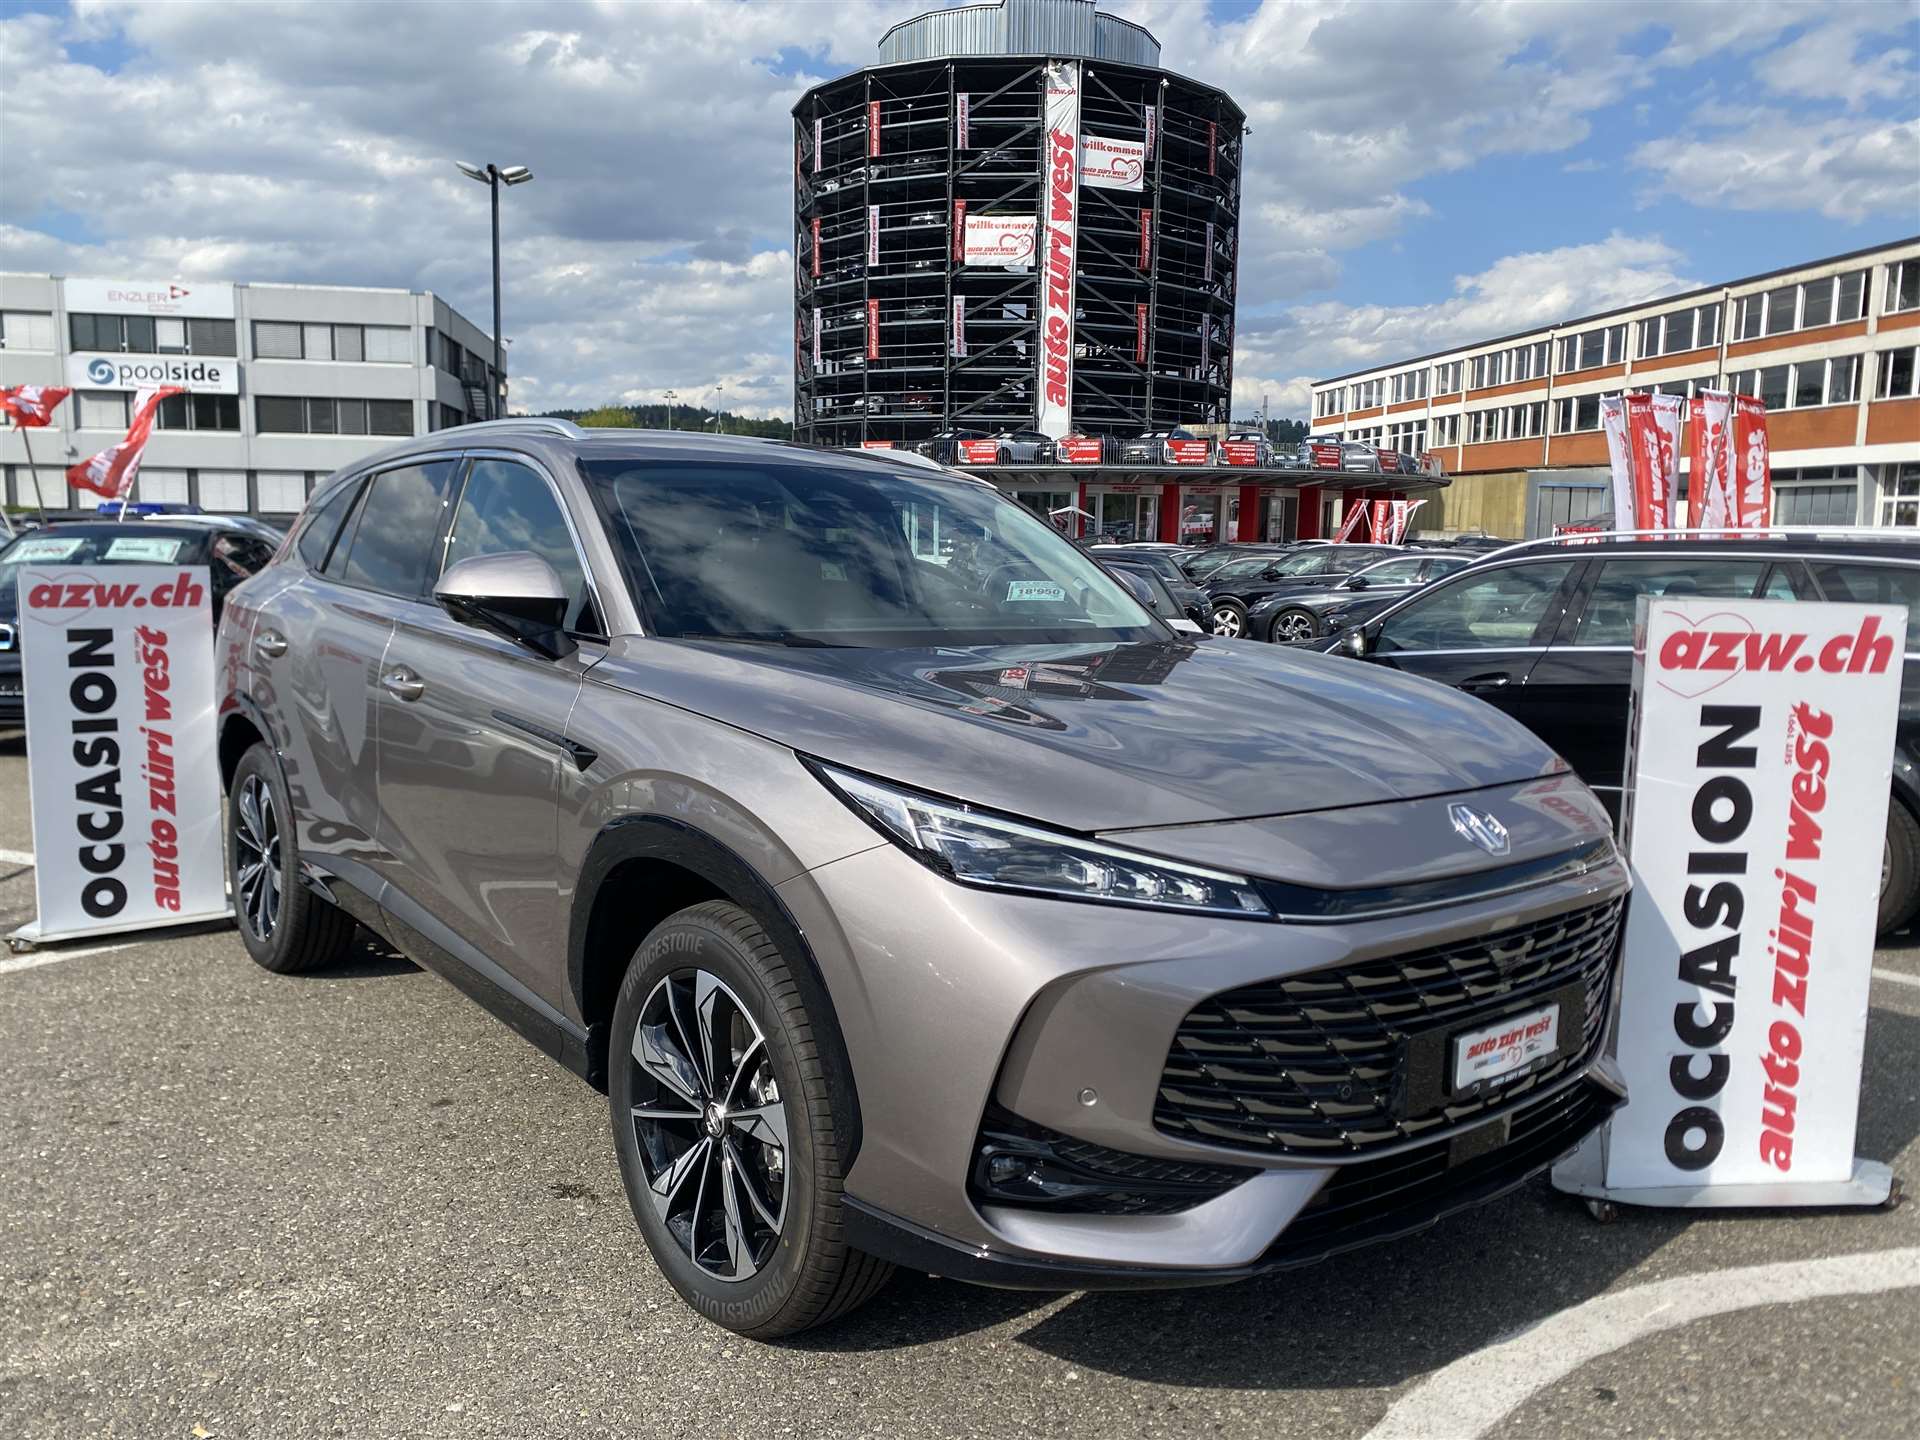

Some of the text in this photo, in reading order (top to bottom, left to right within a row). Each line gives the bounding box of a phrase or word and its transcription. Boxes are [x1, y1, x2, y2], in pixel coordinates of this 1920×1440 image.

[1082, 141, 1143, 156] willkommen
[967, 221, 1035, 230] willkommen
[107, 290, 168, 303] ENZLER
[1044, 127, 1075, 407] auto züri west
[119, 362, 221, 386] poolside
[1643, 427, 1664, 500] west
[28, 573, 205, 610] azw.ch
[1018, 587, 1060, 596] 18'950
[1659, 615, 1896, 675] azw.ch
[67, 628, 128, 919] OCCASION
[135, 625, 181, 913] auto züri west
[623, 932, 705, 1001] BRIDGESTONE
[1664, 705, 1763, 1173] OCCASION
[1759, 701, 1834, 1173] auto züri west
[1466, 1036, 1498, 1060] auto
[1526, 1016, 1552, 1038] west
